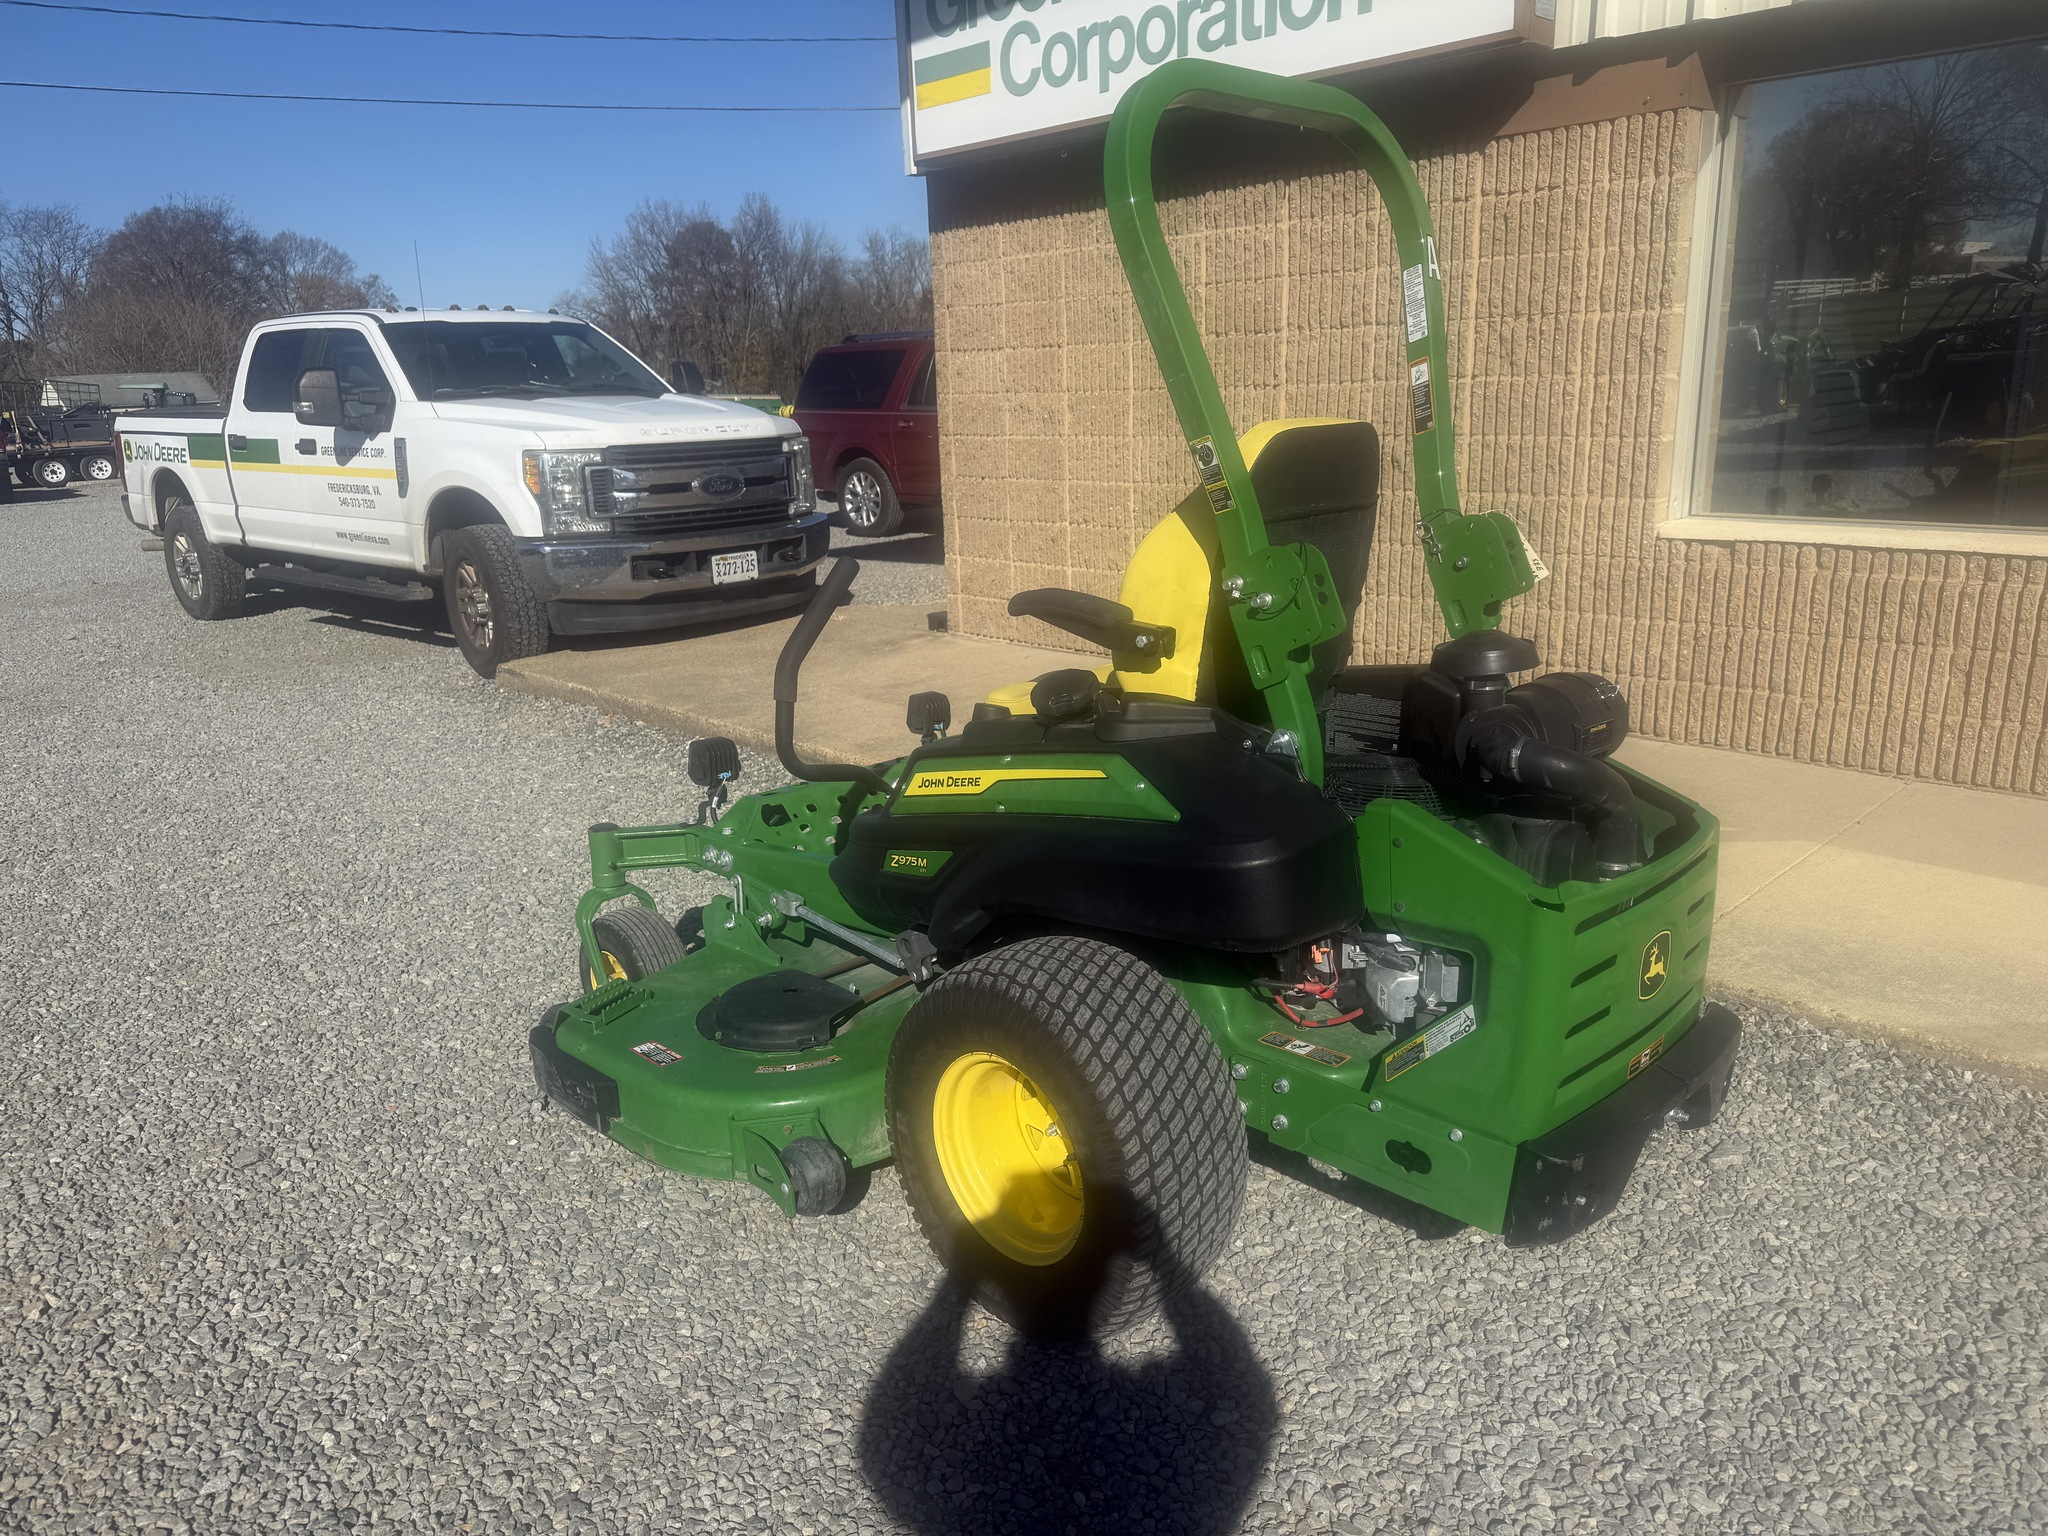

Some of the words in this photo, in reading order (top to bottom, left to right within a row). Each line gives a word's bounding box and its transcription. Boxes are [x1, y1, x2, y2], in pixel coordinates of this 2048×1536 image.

[1427, 235, 1441, 280] A
[134, 441, 153, 460] JOHN
[154, 442, 187, 463] DEERE
[347, 447, 369, 458] SERVICE
[370, 448, 387, 459] CORP.
[709, 479, 733, 492] Ford
[918, 777, 945, 788] JOHN
[946, 776, 981, 787] DEERE
[891, 855, 927, 867] Z975M
